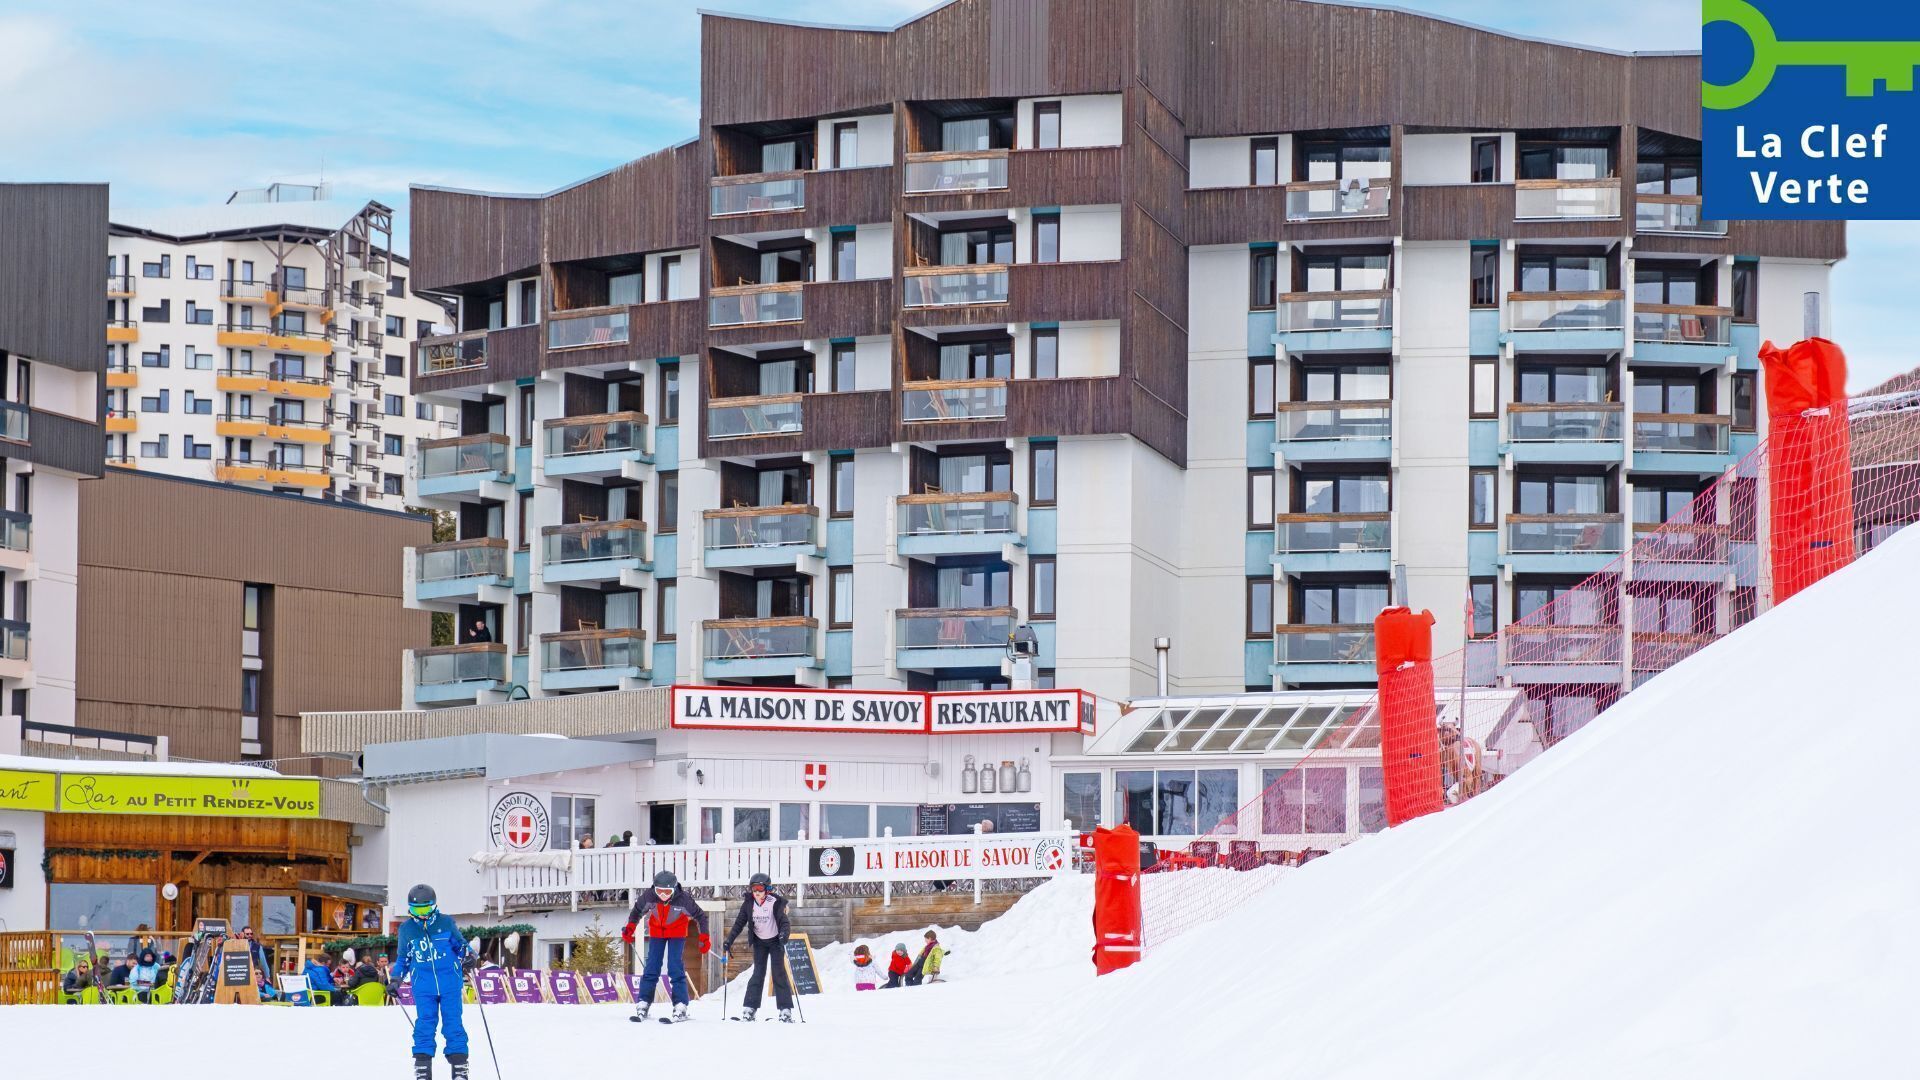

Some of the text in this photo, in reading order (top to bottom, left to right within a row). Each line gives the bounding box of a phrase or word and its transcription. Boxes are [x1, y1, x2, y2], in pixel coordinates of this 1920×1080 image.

[685, 695, 922, 723] LA MAISON DE SAVOY
[937, 699, 1071, 724] RESTAURANT
[65, 776, 119, 810] Bar
[126, 796, 148, 806] AU
[866, 852, 883, 870] LA
[895, 849, 949, 869] MAISON
[954, 848, 972, 867] DE
[981, 846, 1032, 867] SAVOY
